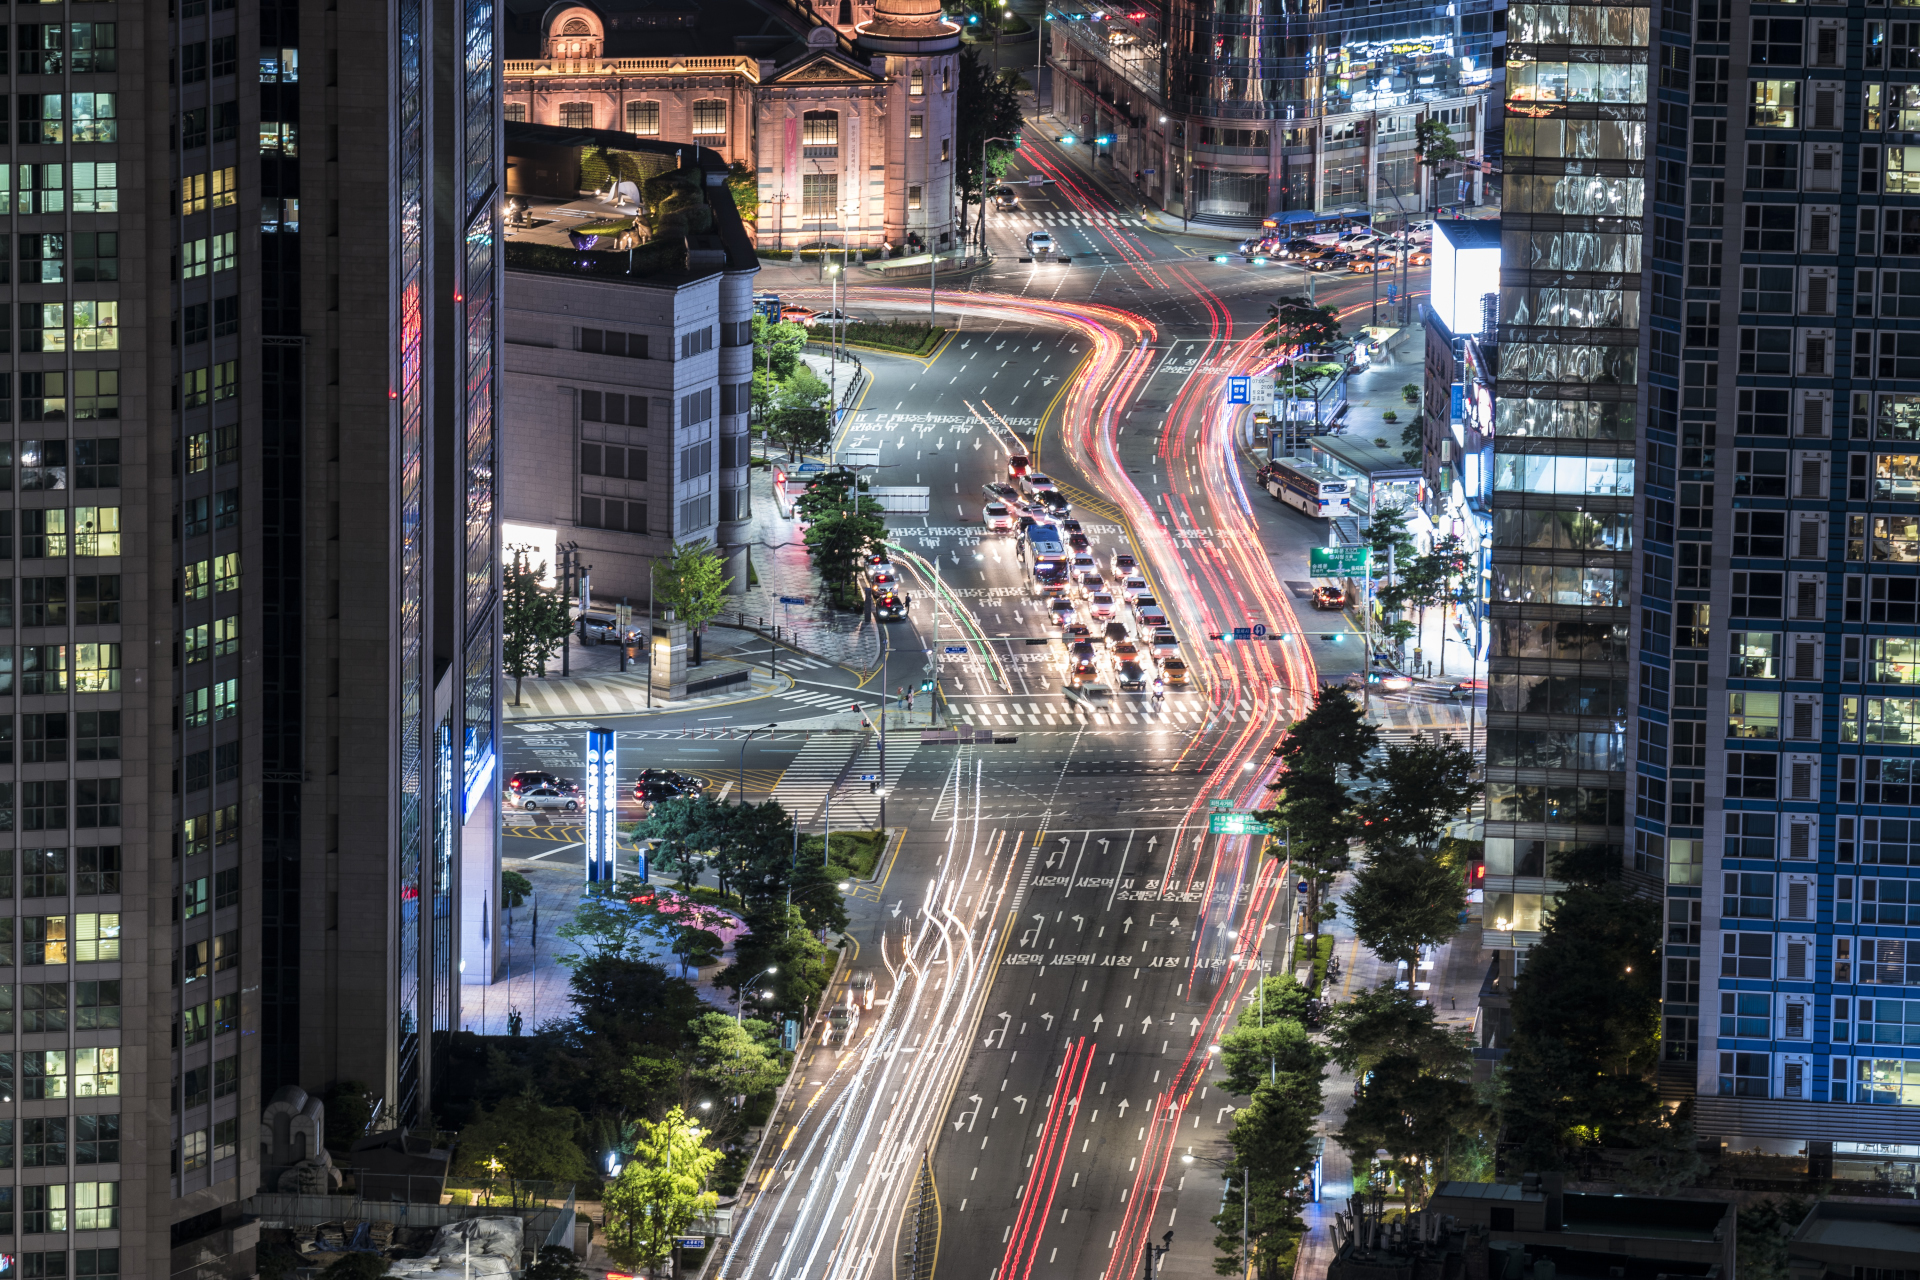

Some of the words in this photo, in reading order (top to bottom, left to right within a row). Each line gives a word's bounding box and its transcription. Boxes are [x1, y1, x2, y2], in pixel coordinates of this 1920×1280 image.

[1030, 876, 1070, 887] 서울역
[1075, 877, 1115, 888] 서울역
[1117, 891, 1158, 901] 숭례문
[1002, 953, 1045, 965] 서울역
[1049, 954, 1092, 965] 서울역
[1100, 955, 1132, 967] 시청
[1148, 957, 1180, 968] 시청
